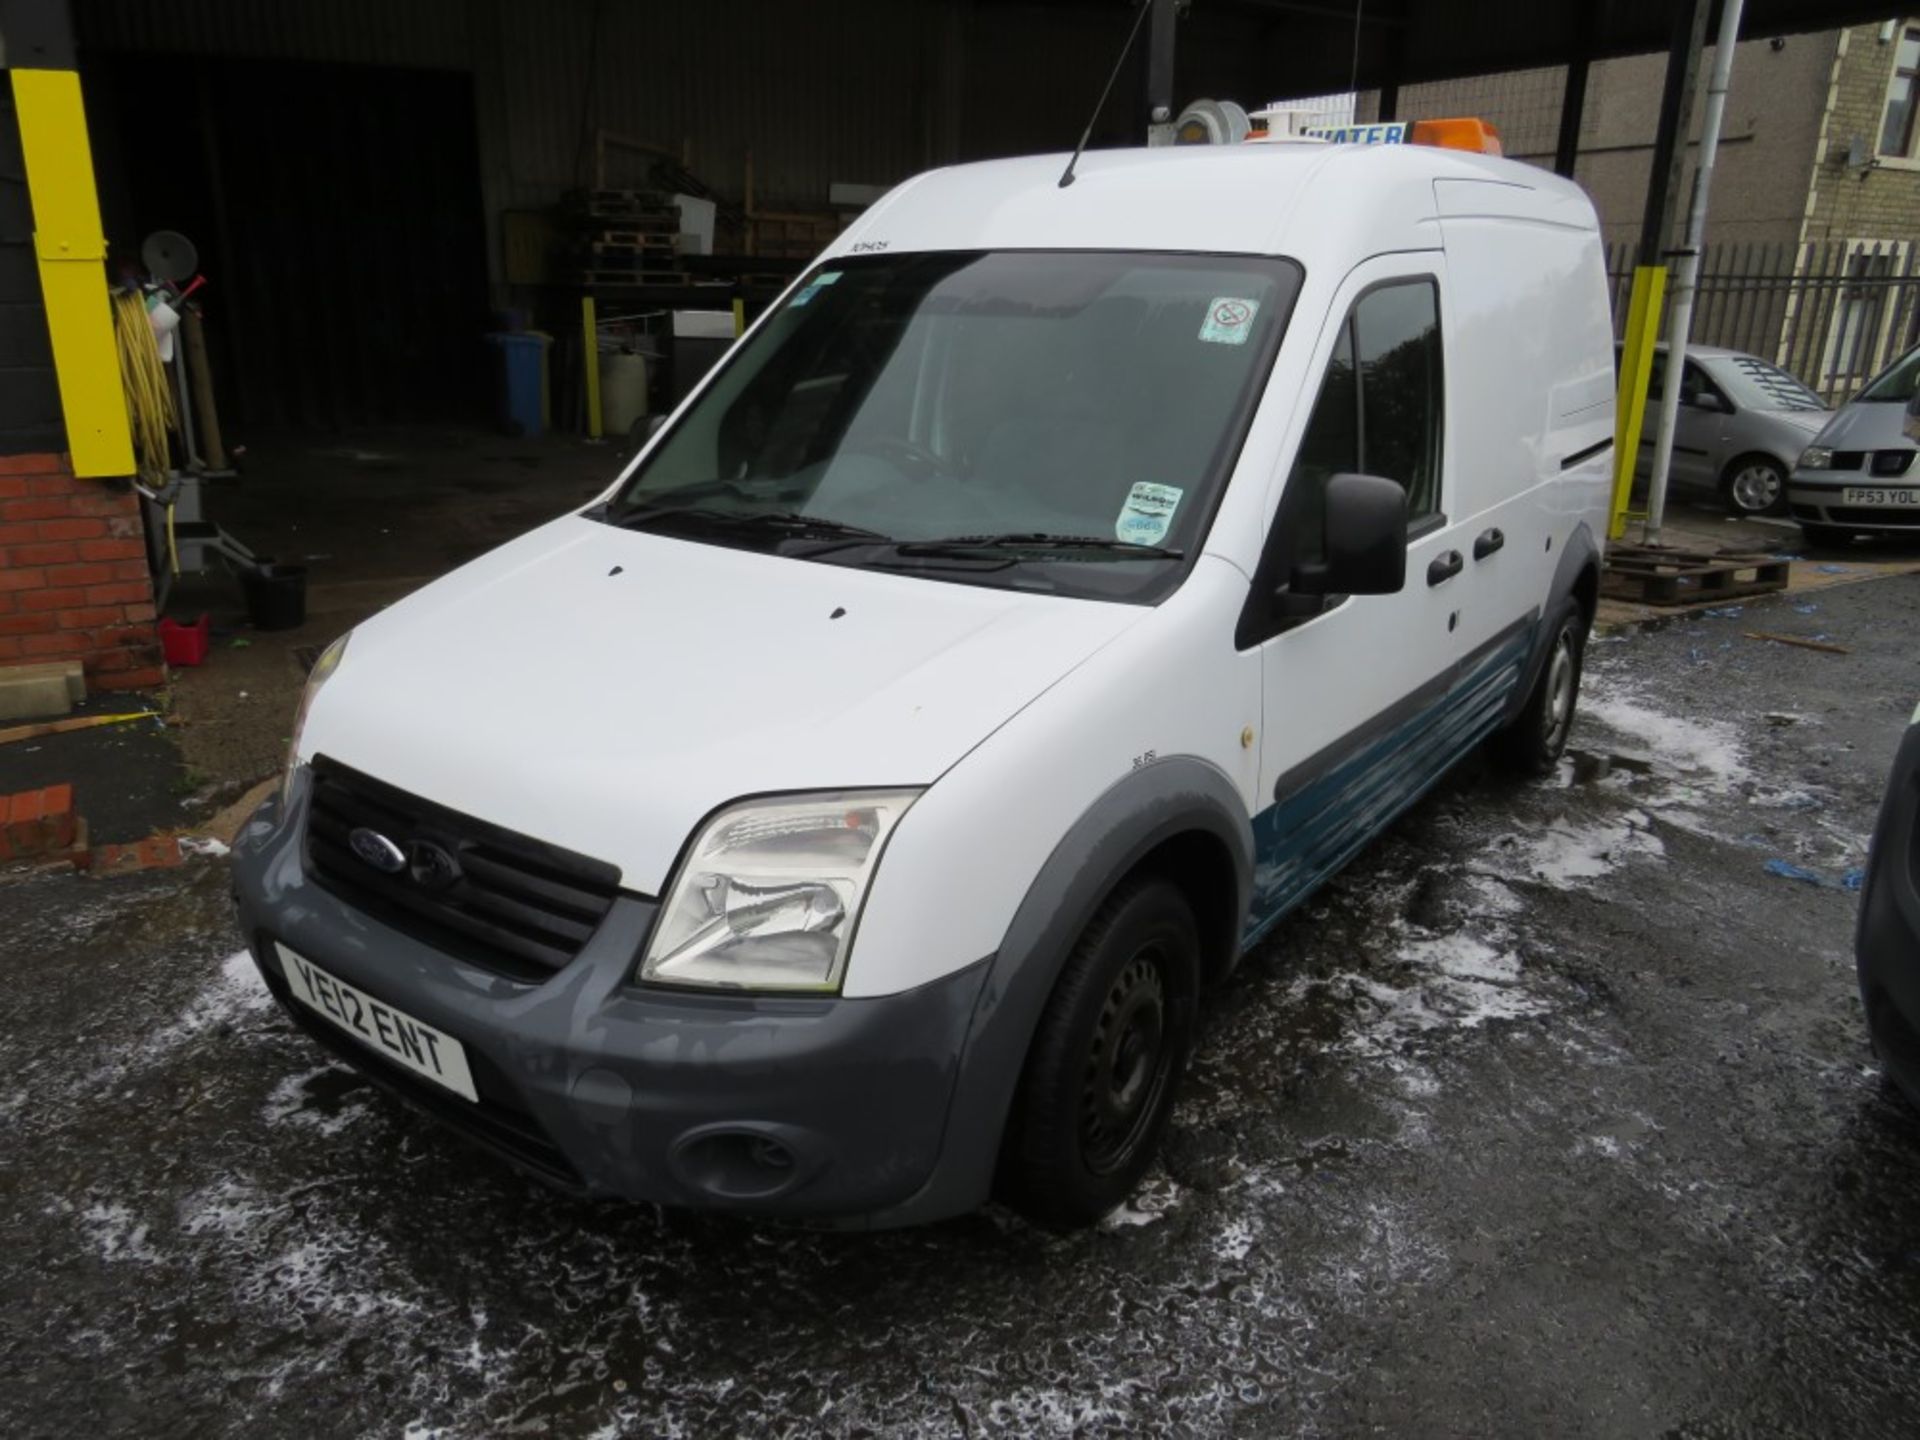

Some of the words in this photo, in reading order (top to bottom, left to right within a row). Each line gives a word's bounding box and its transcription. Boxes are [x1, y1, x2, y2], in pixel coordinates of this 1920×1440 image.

[1848, 490, 1885, 503] FP53
[1888, 490, 1919, 504] YOL
[293, 957, 371, 1037] YE12
[368, 1002, 443, 1076] ENT
